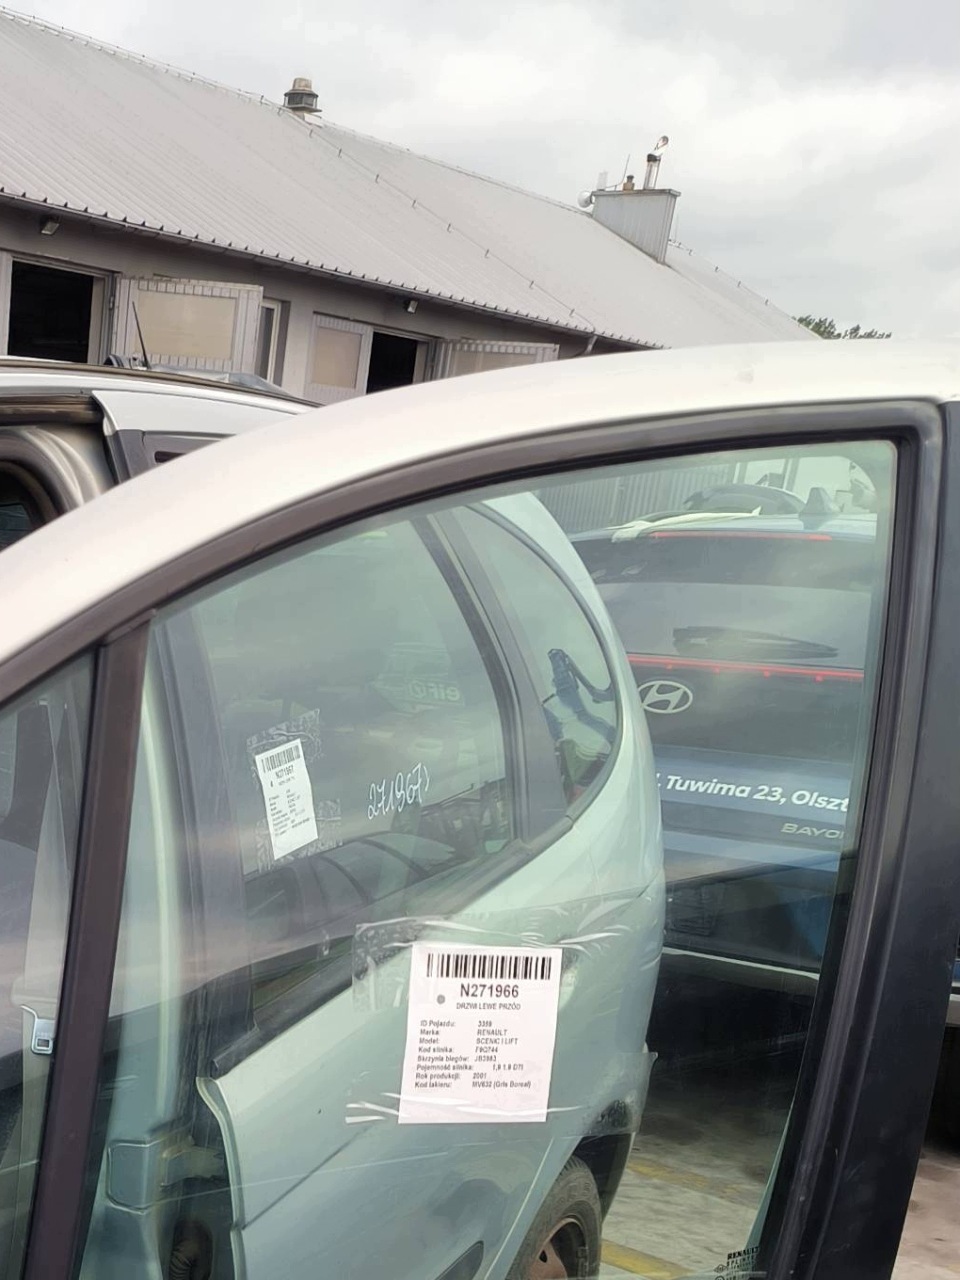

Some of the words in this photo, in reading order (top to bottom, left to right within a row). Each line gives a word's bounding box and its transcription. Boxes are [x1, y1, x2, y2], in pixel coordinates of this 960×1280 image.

[666, 775, 751, 798] Tuwima
[753, 785, 787, 806] 23,
[781, 823, 845, 840] BAYO
[460, 983, 519, 998] N271966
[456, 1002, 477, 1010] DRZWI
[479, 1002, 497, 1010] LEWE
[498, 1001, 521, 1011] PRZÓD
[476, 1037, 500, 1045] SCENIC
[504, 1037, 518, 1045] LIFT
[429, 1072, 460, 1081] produkcji:
[727, 1246, 759, 1260] RENAULT
